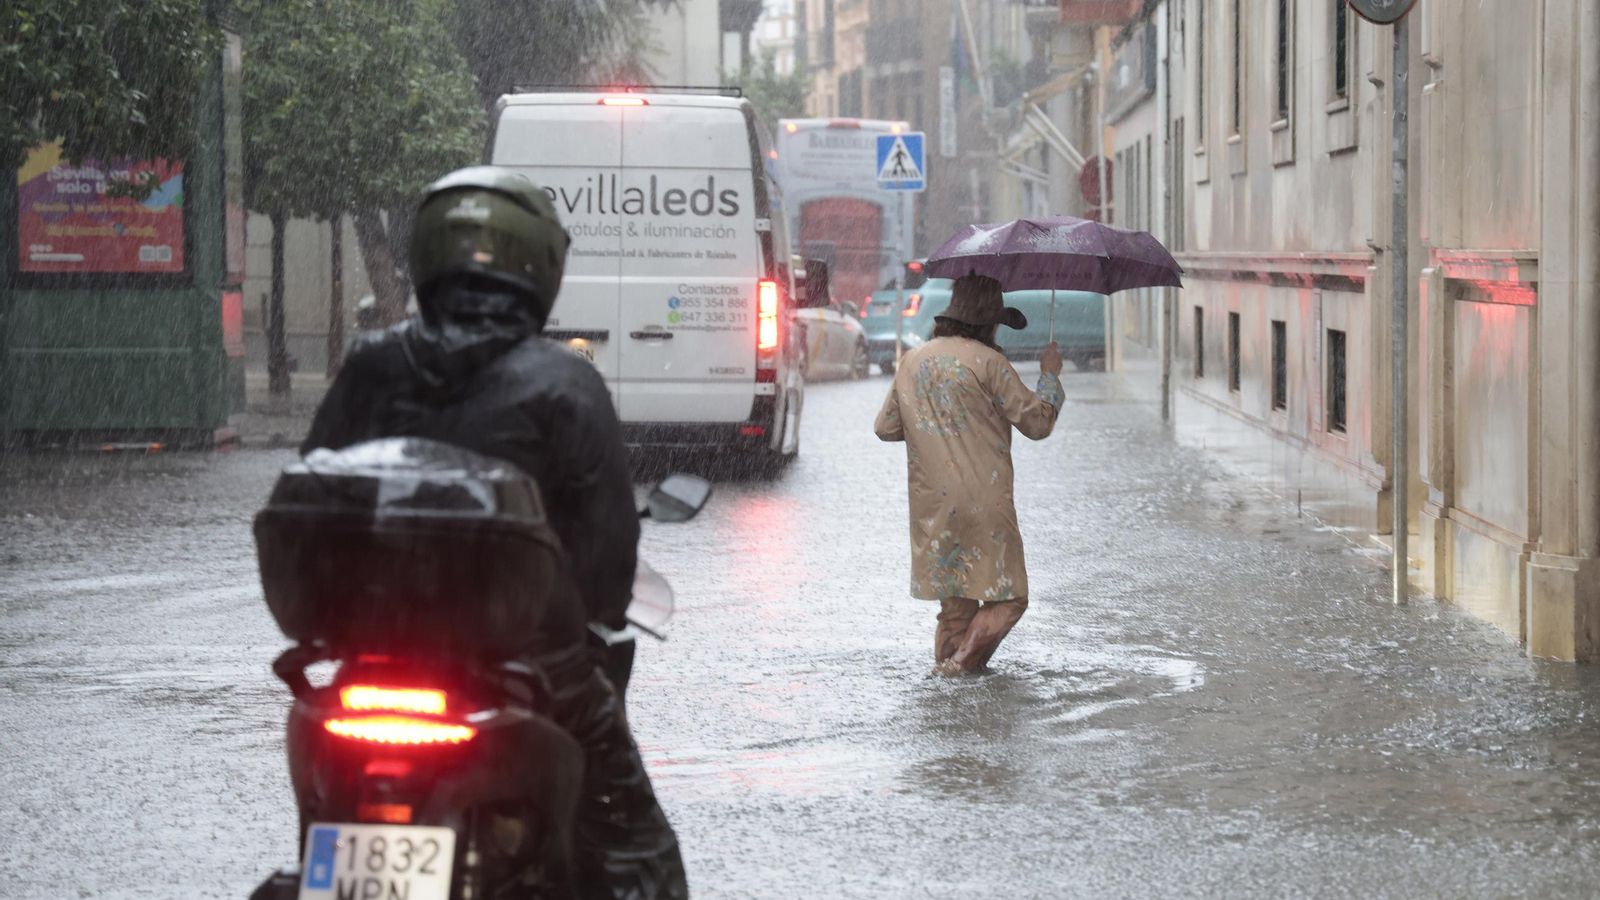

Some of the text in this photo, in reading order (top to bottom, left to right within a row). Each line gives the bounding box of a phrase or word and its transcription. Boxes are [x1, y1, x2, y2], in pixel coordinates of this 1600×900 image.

[567, 221, 736, 239] rótulos & iluminación
[679, 283, 739, 295] Contactos
[681, 298, 701, 308] 955
[704, 297, 725, 308] 354
[681, 311, 748, 323] 647 336 311
[347, 835, 439, 875] 1832
